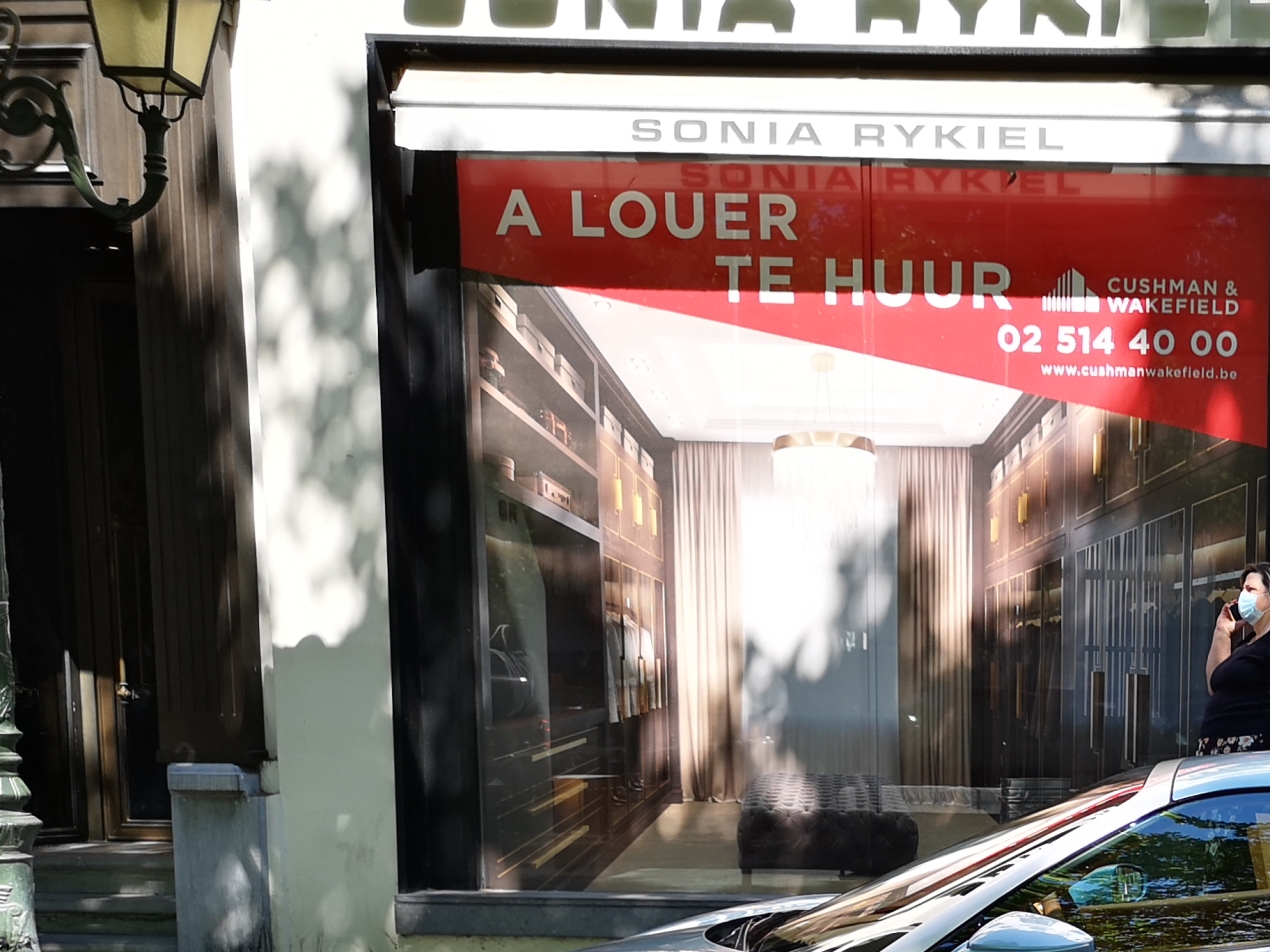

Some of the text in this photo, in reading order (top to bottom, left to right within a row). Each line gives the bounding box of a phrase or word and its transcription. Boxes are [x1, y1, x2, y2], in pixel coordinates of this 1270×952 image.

[631, 119, 1064, 152] SONIA RYKIEL
[680, 163, 859, 191] SONIA
[495, 188, 799, 242] A LOUER
[714, 255, 1013, 311] TE HUUR
[1107, 277, 1239, 297] CUSHMAN &
[1106, 296, 1240, 316] WAKEFIELD
[996, 323, 1239, 358] 02 514 40 00
[1040, 363, 1238, 381] www.cushmanwakefield.be
